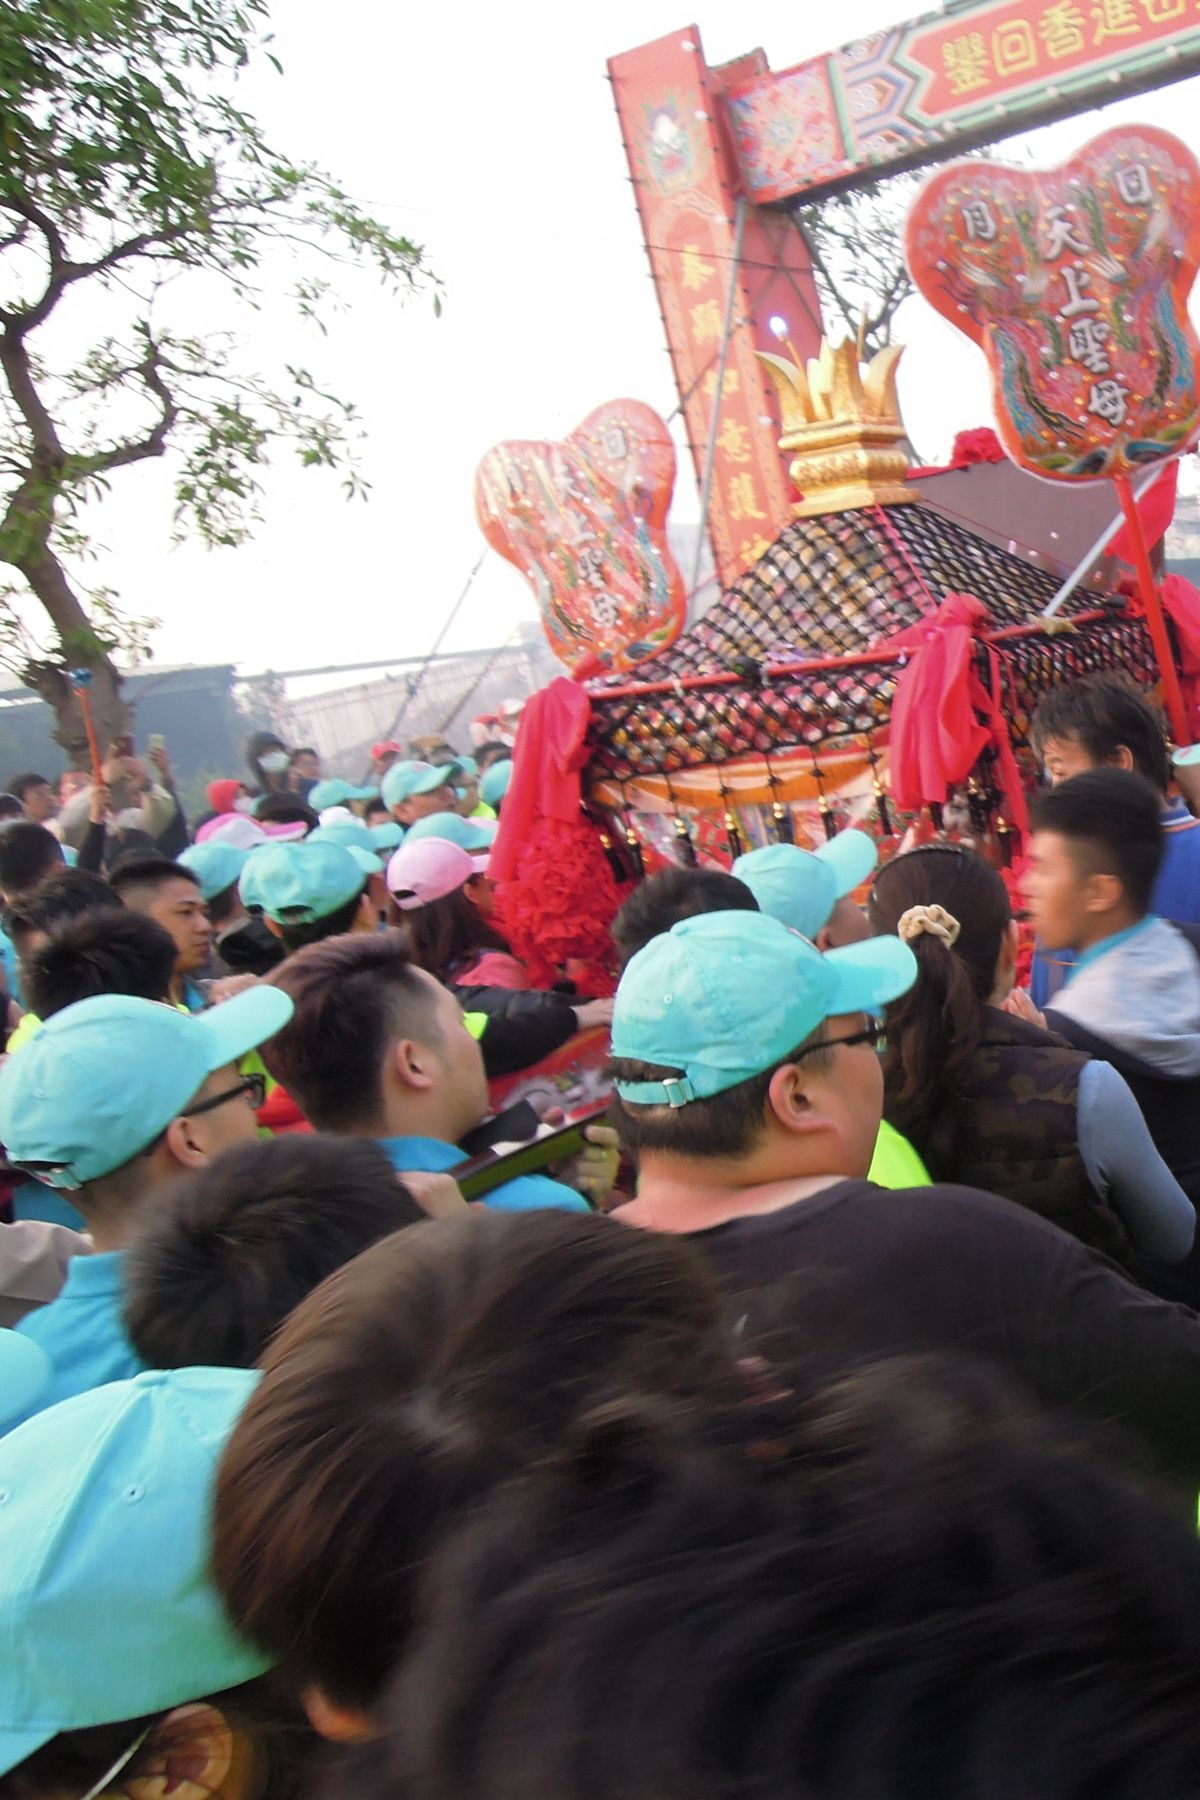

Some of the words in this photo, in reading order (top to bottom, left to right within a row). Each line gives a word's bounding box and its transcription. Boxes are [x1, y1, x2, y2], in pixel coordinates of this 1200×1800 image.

[961, 199, 997, 243] 月
[1041, 205, 1131, 428] 天上聖母
